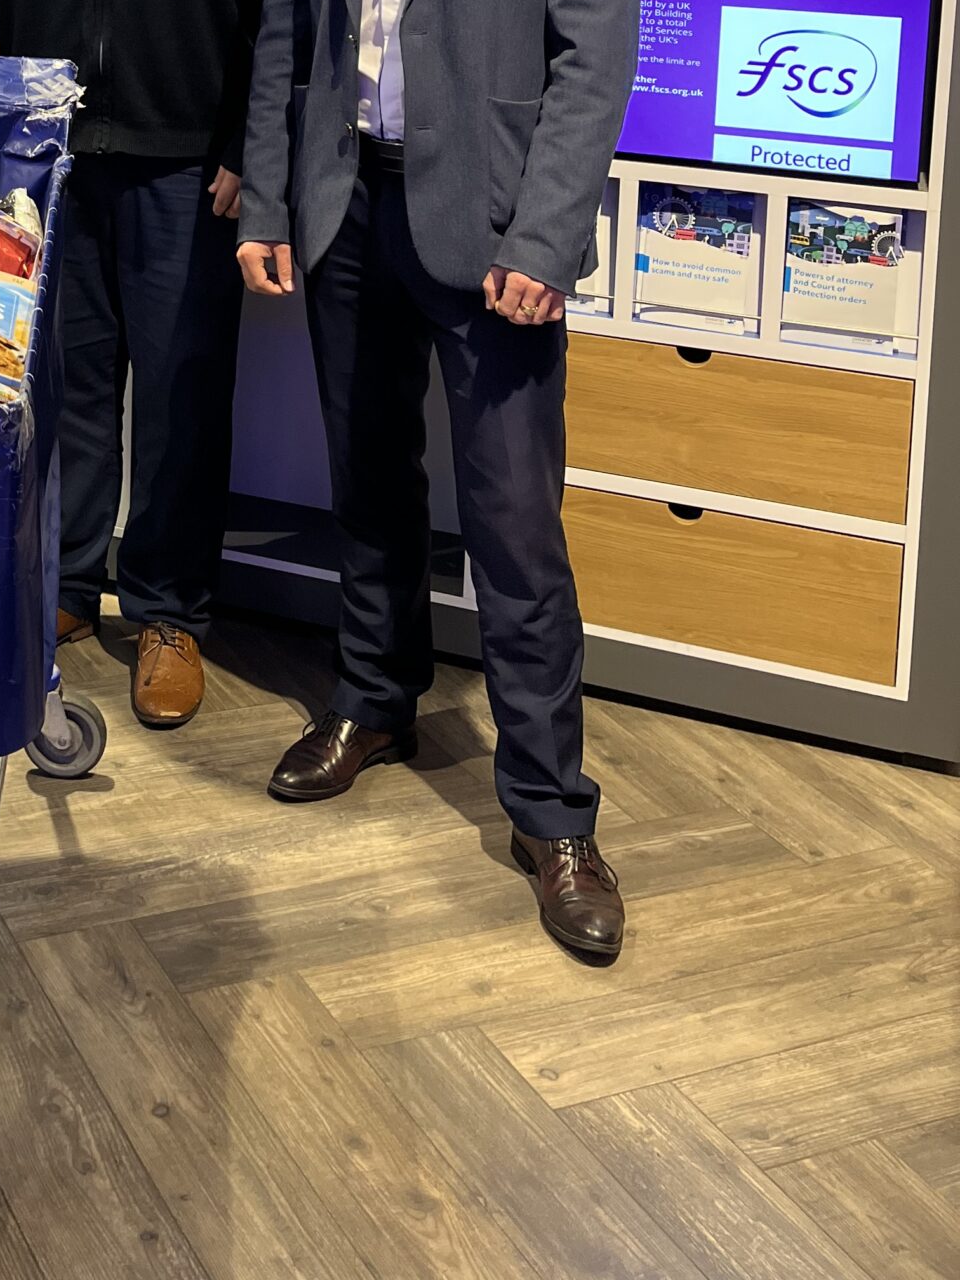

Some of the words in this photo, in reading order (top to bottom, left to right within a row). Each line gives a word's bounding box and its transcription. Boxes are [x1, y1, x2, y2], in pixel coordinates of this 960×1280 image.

[656, 27, 693, 36] Services
[750, 144, 850, 171] Protected
[652, 257, 670, 265] How
[681, 262, 704, 270] avoid
[704, 265, 741, 275] common
[651, 267, 675, 275] scams
[693, 273, 710, 282] stay
[711, 275, 729, 283] safe
[794, 269, 824, 280] Powers
[836, 277, 873, 288] attorney
[810, 280, 834, 291] Court
[793, 287, 836, 300] Protection
[838, 296, 866, 304] orders
